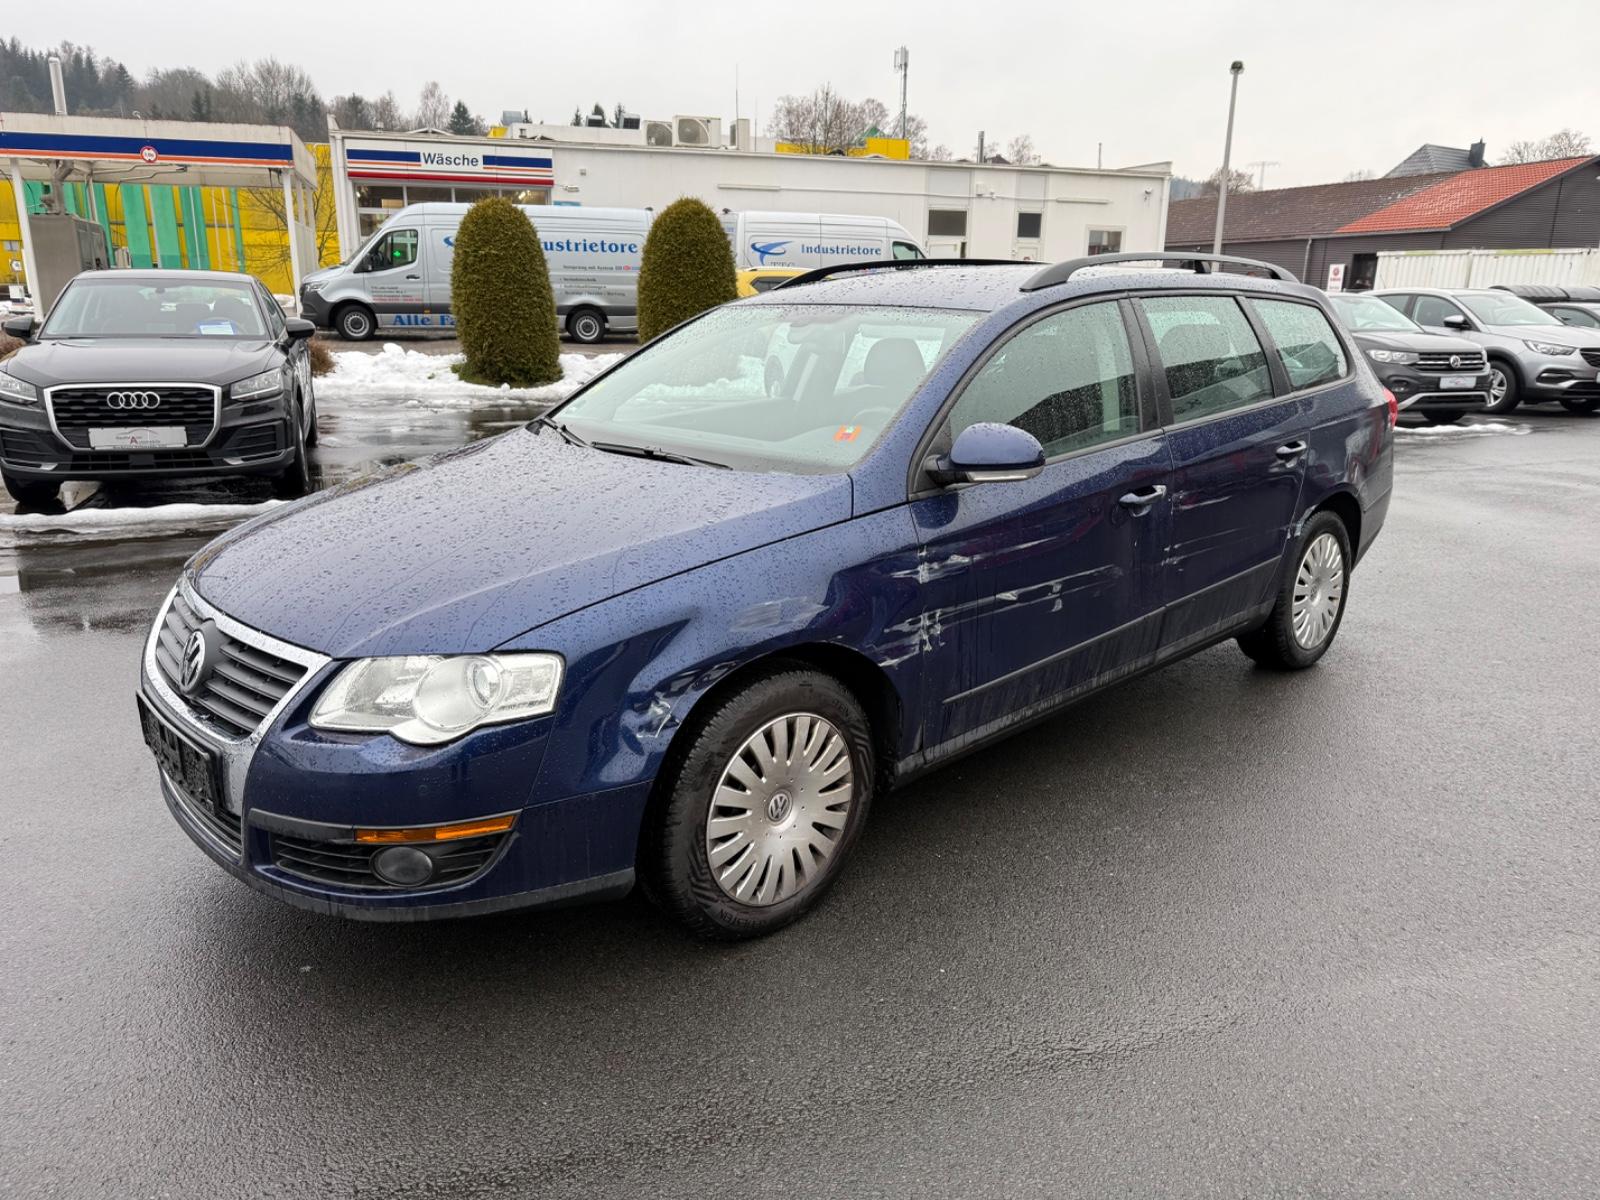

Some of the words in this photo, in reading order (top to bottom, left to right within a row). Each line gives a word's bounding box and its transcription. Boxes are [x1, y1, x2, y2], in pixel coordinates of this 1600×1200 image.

[423, 152, 479, 167] Wäsche
[543, 239, 638, 254] ustrietore
[801, 244, 881, 256] Industrietore
[393, 315, 430, 326] Alle
[439, 315, 456, 326] Fa
